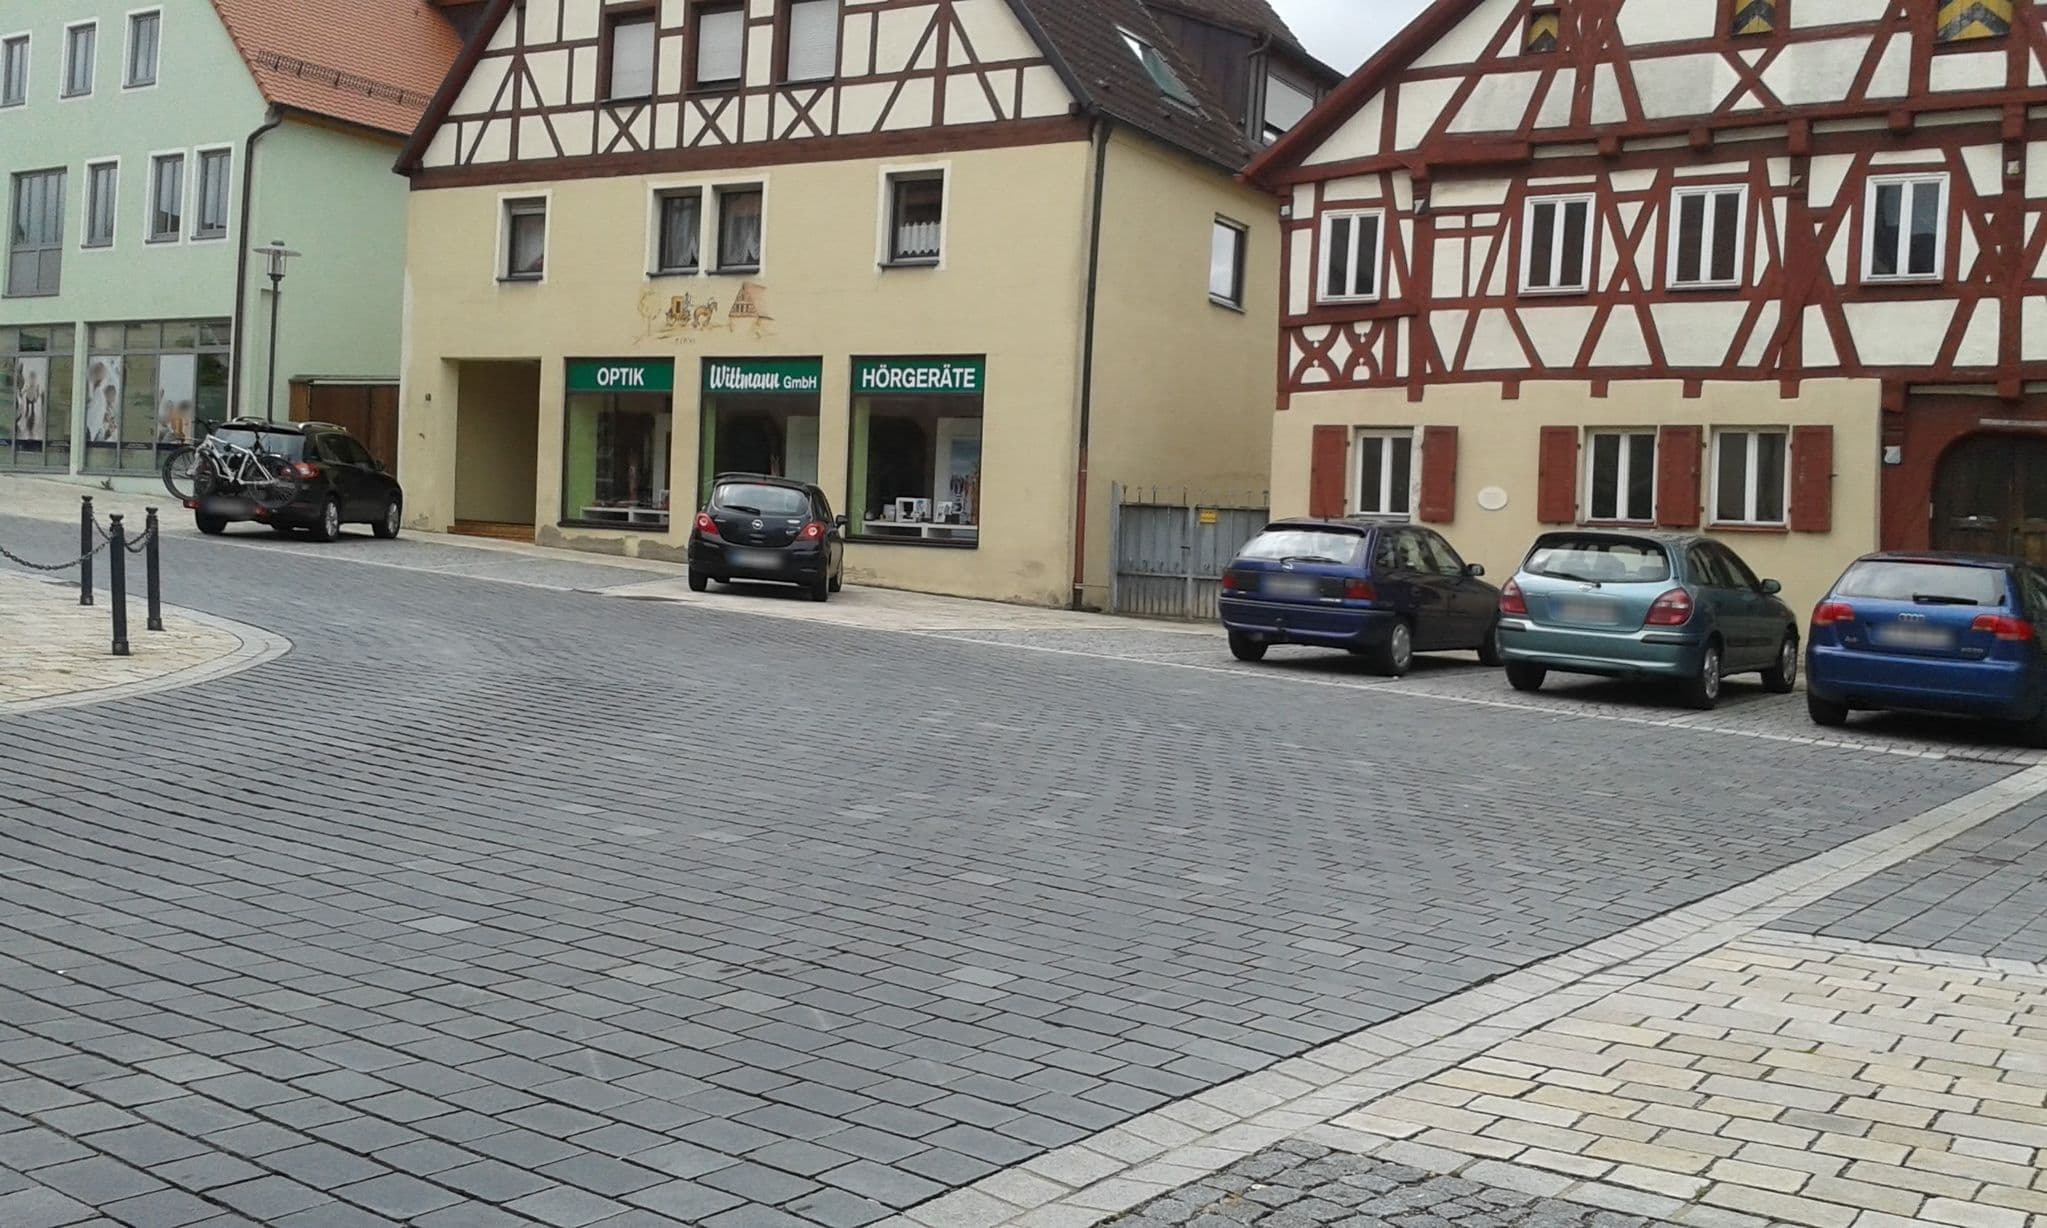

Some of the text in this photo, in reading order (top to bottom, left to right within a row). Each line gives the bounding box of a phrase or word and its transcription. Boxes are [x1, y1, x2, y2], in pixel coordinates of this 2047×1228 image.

[597, 367, 645, 386] OPTIK
[710, 364, 817, 389] Wittmann GmbH
[862, 364, 976, 388] HÖRGERÄTE
